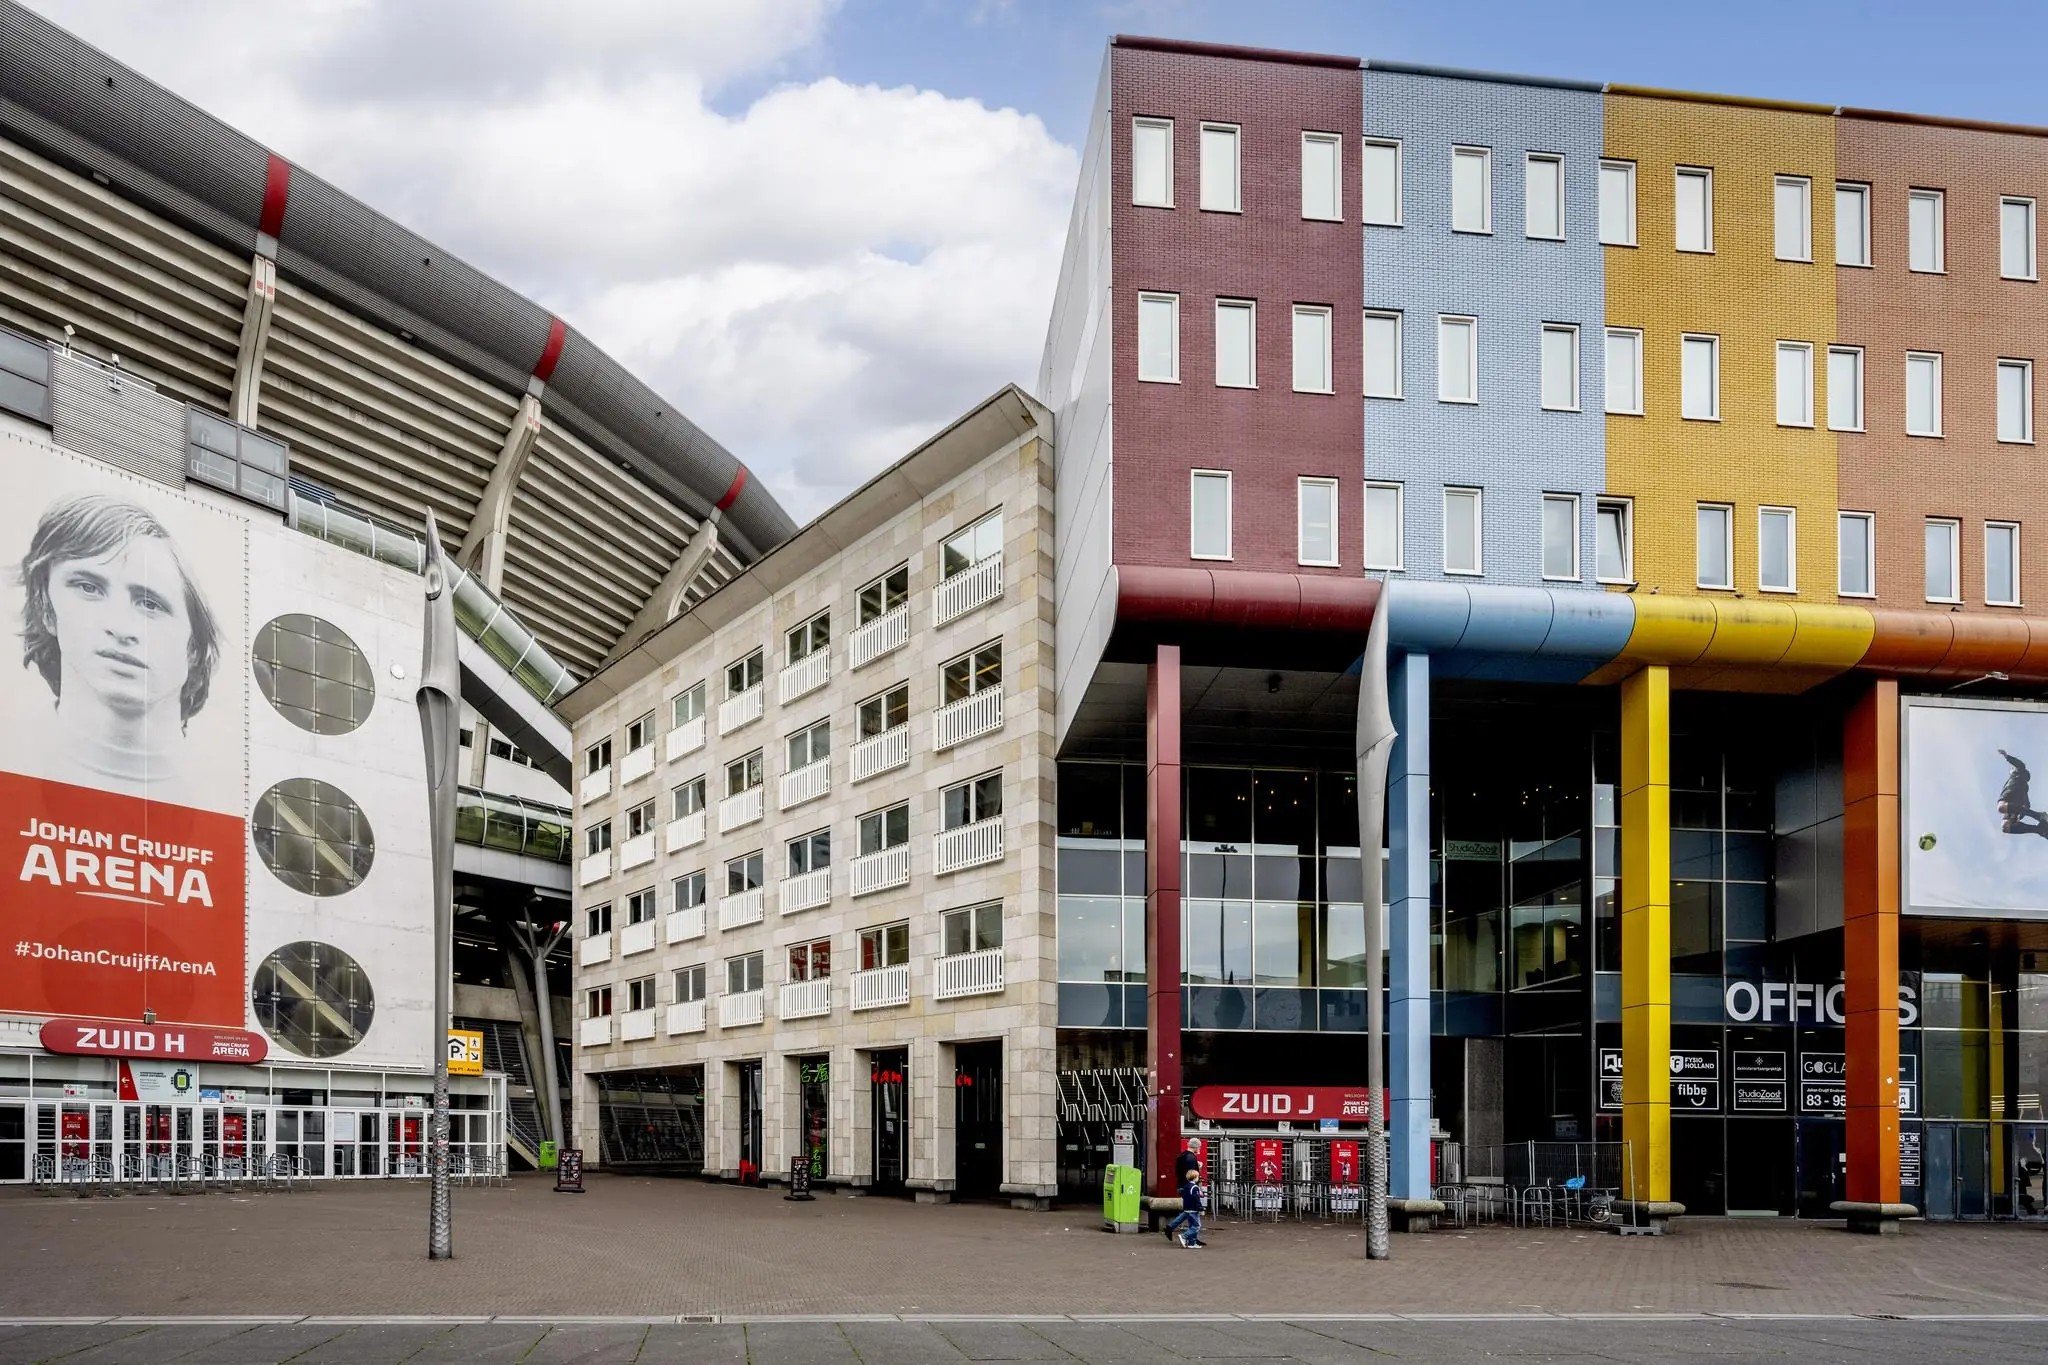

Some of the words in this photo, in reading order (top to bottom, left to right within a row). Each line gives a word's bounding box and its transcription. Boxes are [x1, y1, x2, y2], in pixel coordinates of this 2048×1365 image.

[20, 818, 113, 850] JOHAN
[120, 834, 214, 866] CRUIJFF
[20, 844, 214, 908] ARENA
[15, 941, 217, 976] #JohanCruijffArenA
[1726, 981, 1918, 1026] OFFICS
[76, 1027, 156, 1051] ZUID
[164, 1033, 185, 1053] H
[212, 1047, 250, 1057] ARENA
[1677, 1084, 1707, 1096] fibbe
[1806, 1094, 1822, 1107] 83
[1832, 1095, 1847, 1108] 95
[1222, 1093, 1291, 1113] ZUID
[1298, 1095, 1314, 1114] J
